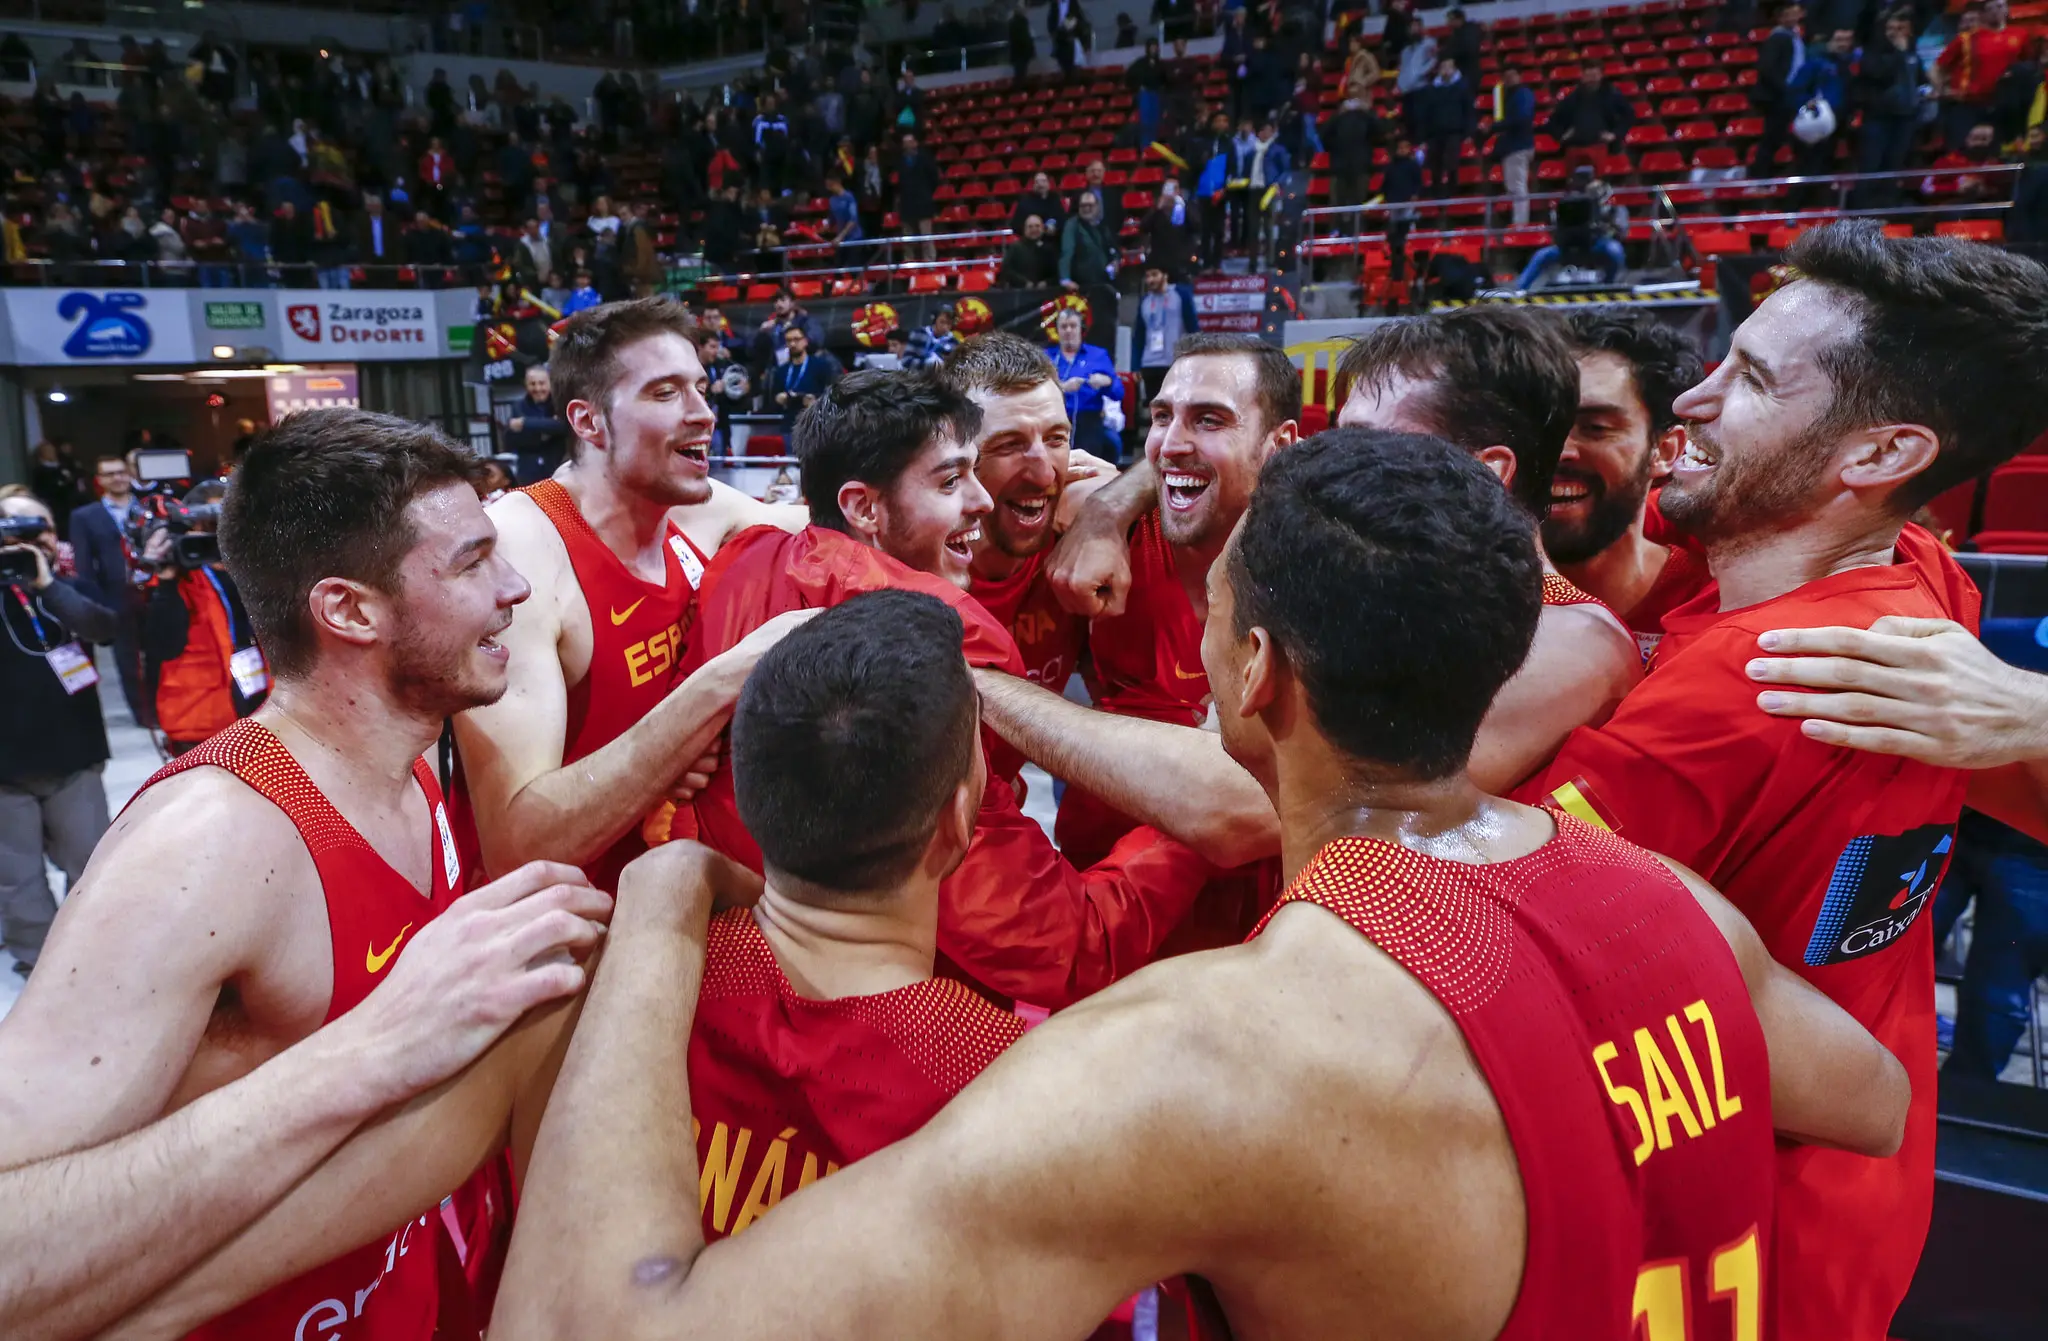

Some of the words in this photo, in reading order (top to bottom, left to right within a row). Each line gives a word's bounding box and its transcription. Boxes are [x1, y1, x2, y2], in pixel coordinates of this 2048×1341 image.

[57, 291, 153, 358] 25
[328, 303, 424, 325] Zaragoza
[331, 325, 424, 343] DEPORTE
[1592, 999, 1742, 1167] SAIZ
